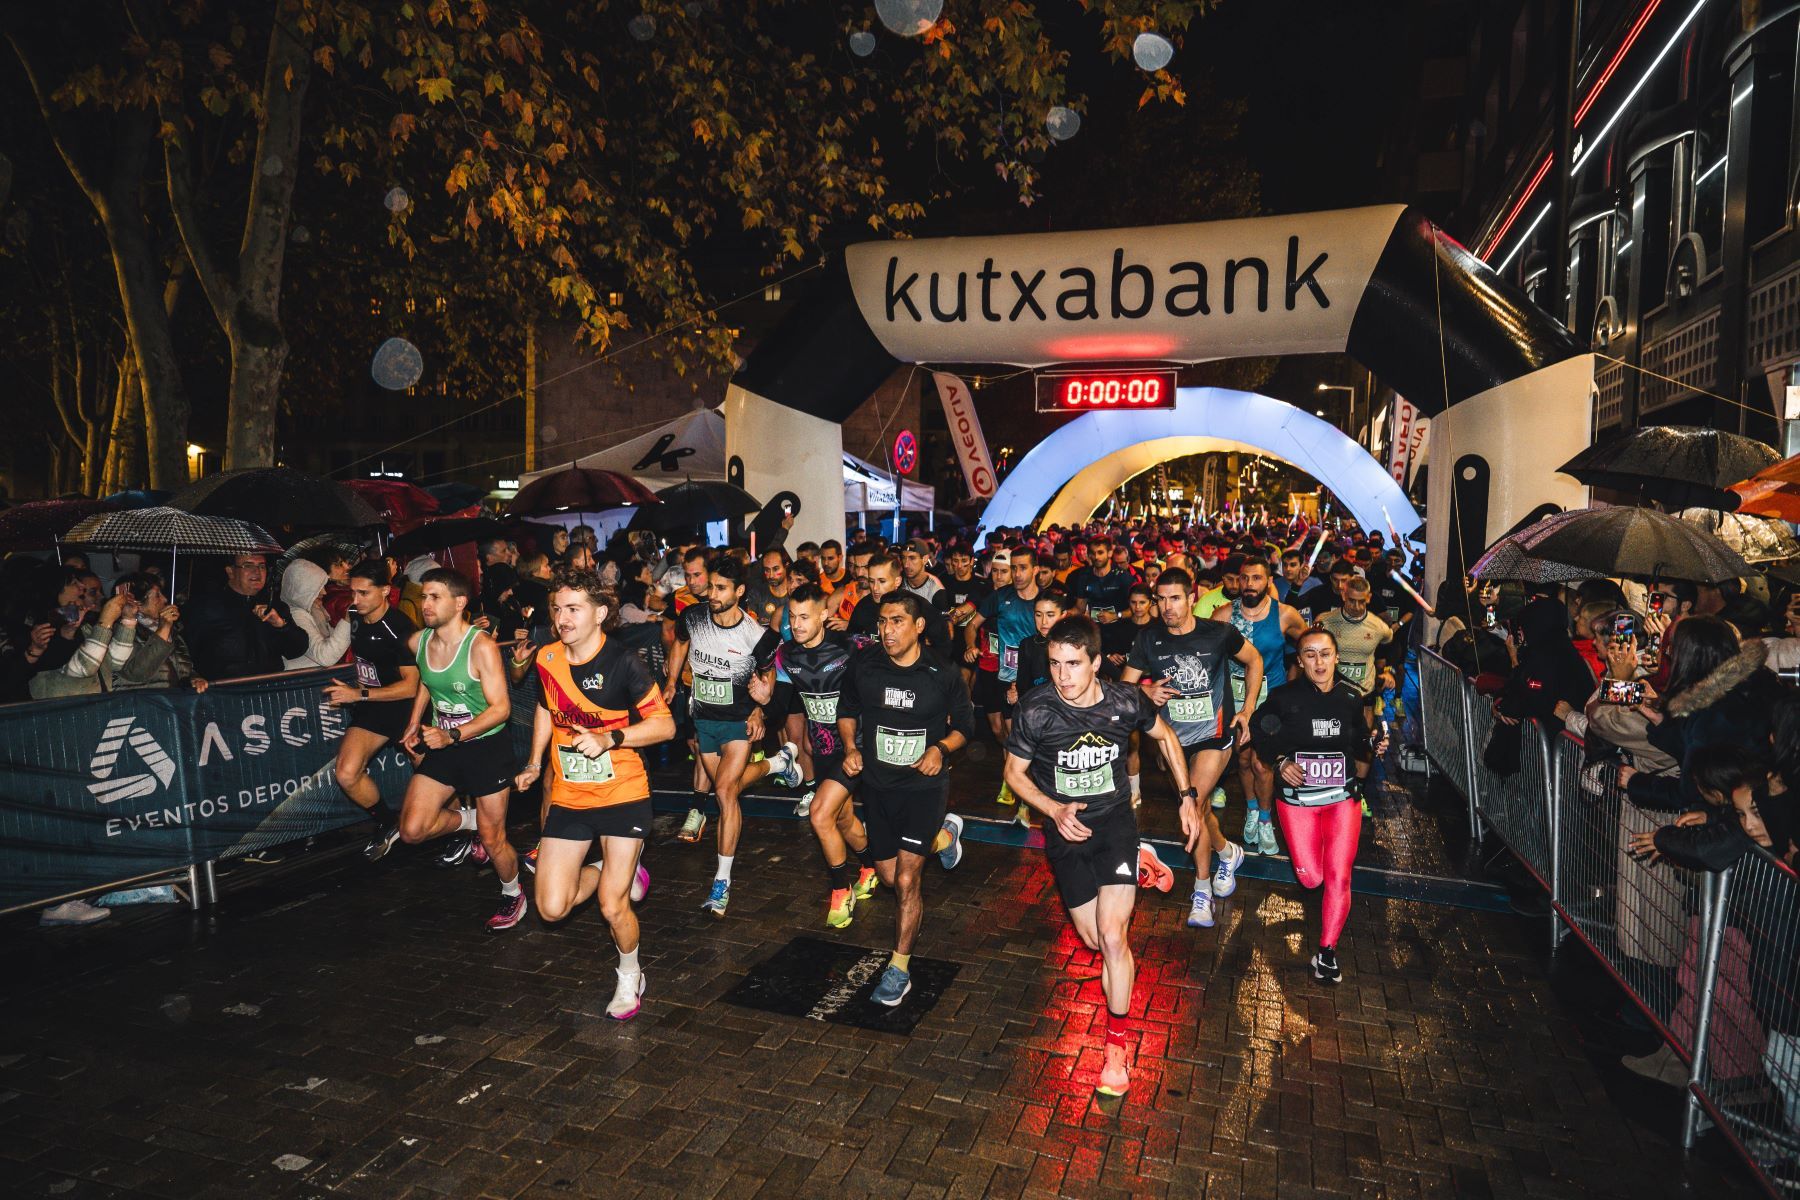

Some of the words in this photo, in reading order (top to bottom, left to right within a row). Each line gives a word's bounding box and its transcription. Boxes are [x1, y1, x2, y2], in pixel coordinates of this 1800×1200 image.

[885, 235, 1331, 322] kutxabank
[1067, 379, 1160, 405] 0:00:00
[1397, 400, 1412, 454] VEO
[1409, 425, 1427, 462] OLIA
[694, 649, 731, 668] RULISA
[699, 682, 726, 698] 840
[808, 700, 836, 716] 838
[1175, 700, 1206, 715] 682
[550, 709, 604, 727] FORONDA
[884, 738, 917, 756] 677
[566, 755, 603, 774] 275
[1299, 761, 1343, 778] 1002
[1065, 771, 1104, 789] 655
[106, 795, 229, 838] EVENTOS
[239, 767, 370, 809] DEPORTI
[376, 755, 387, 772] Y
[395, 752, 410, 767] C
